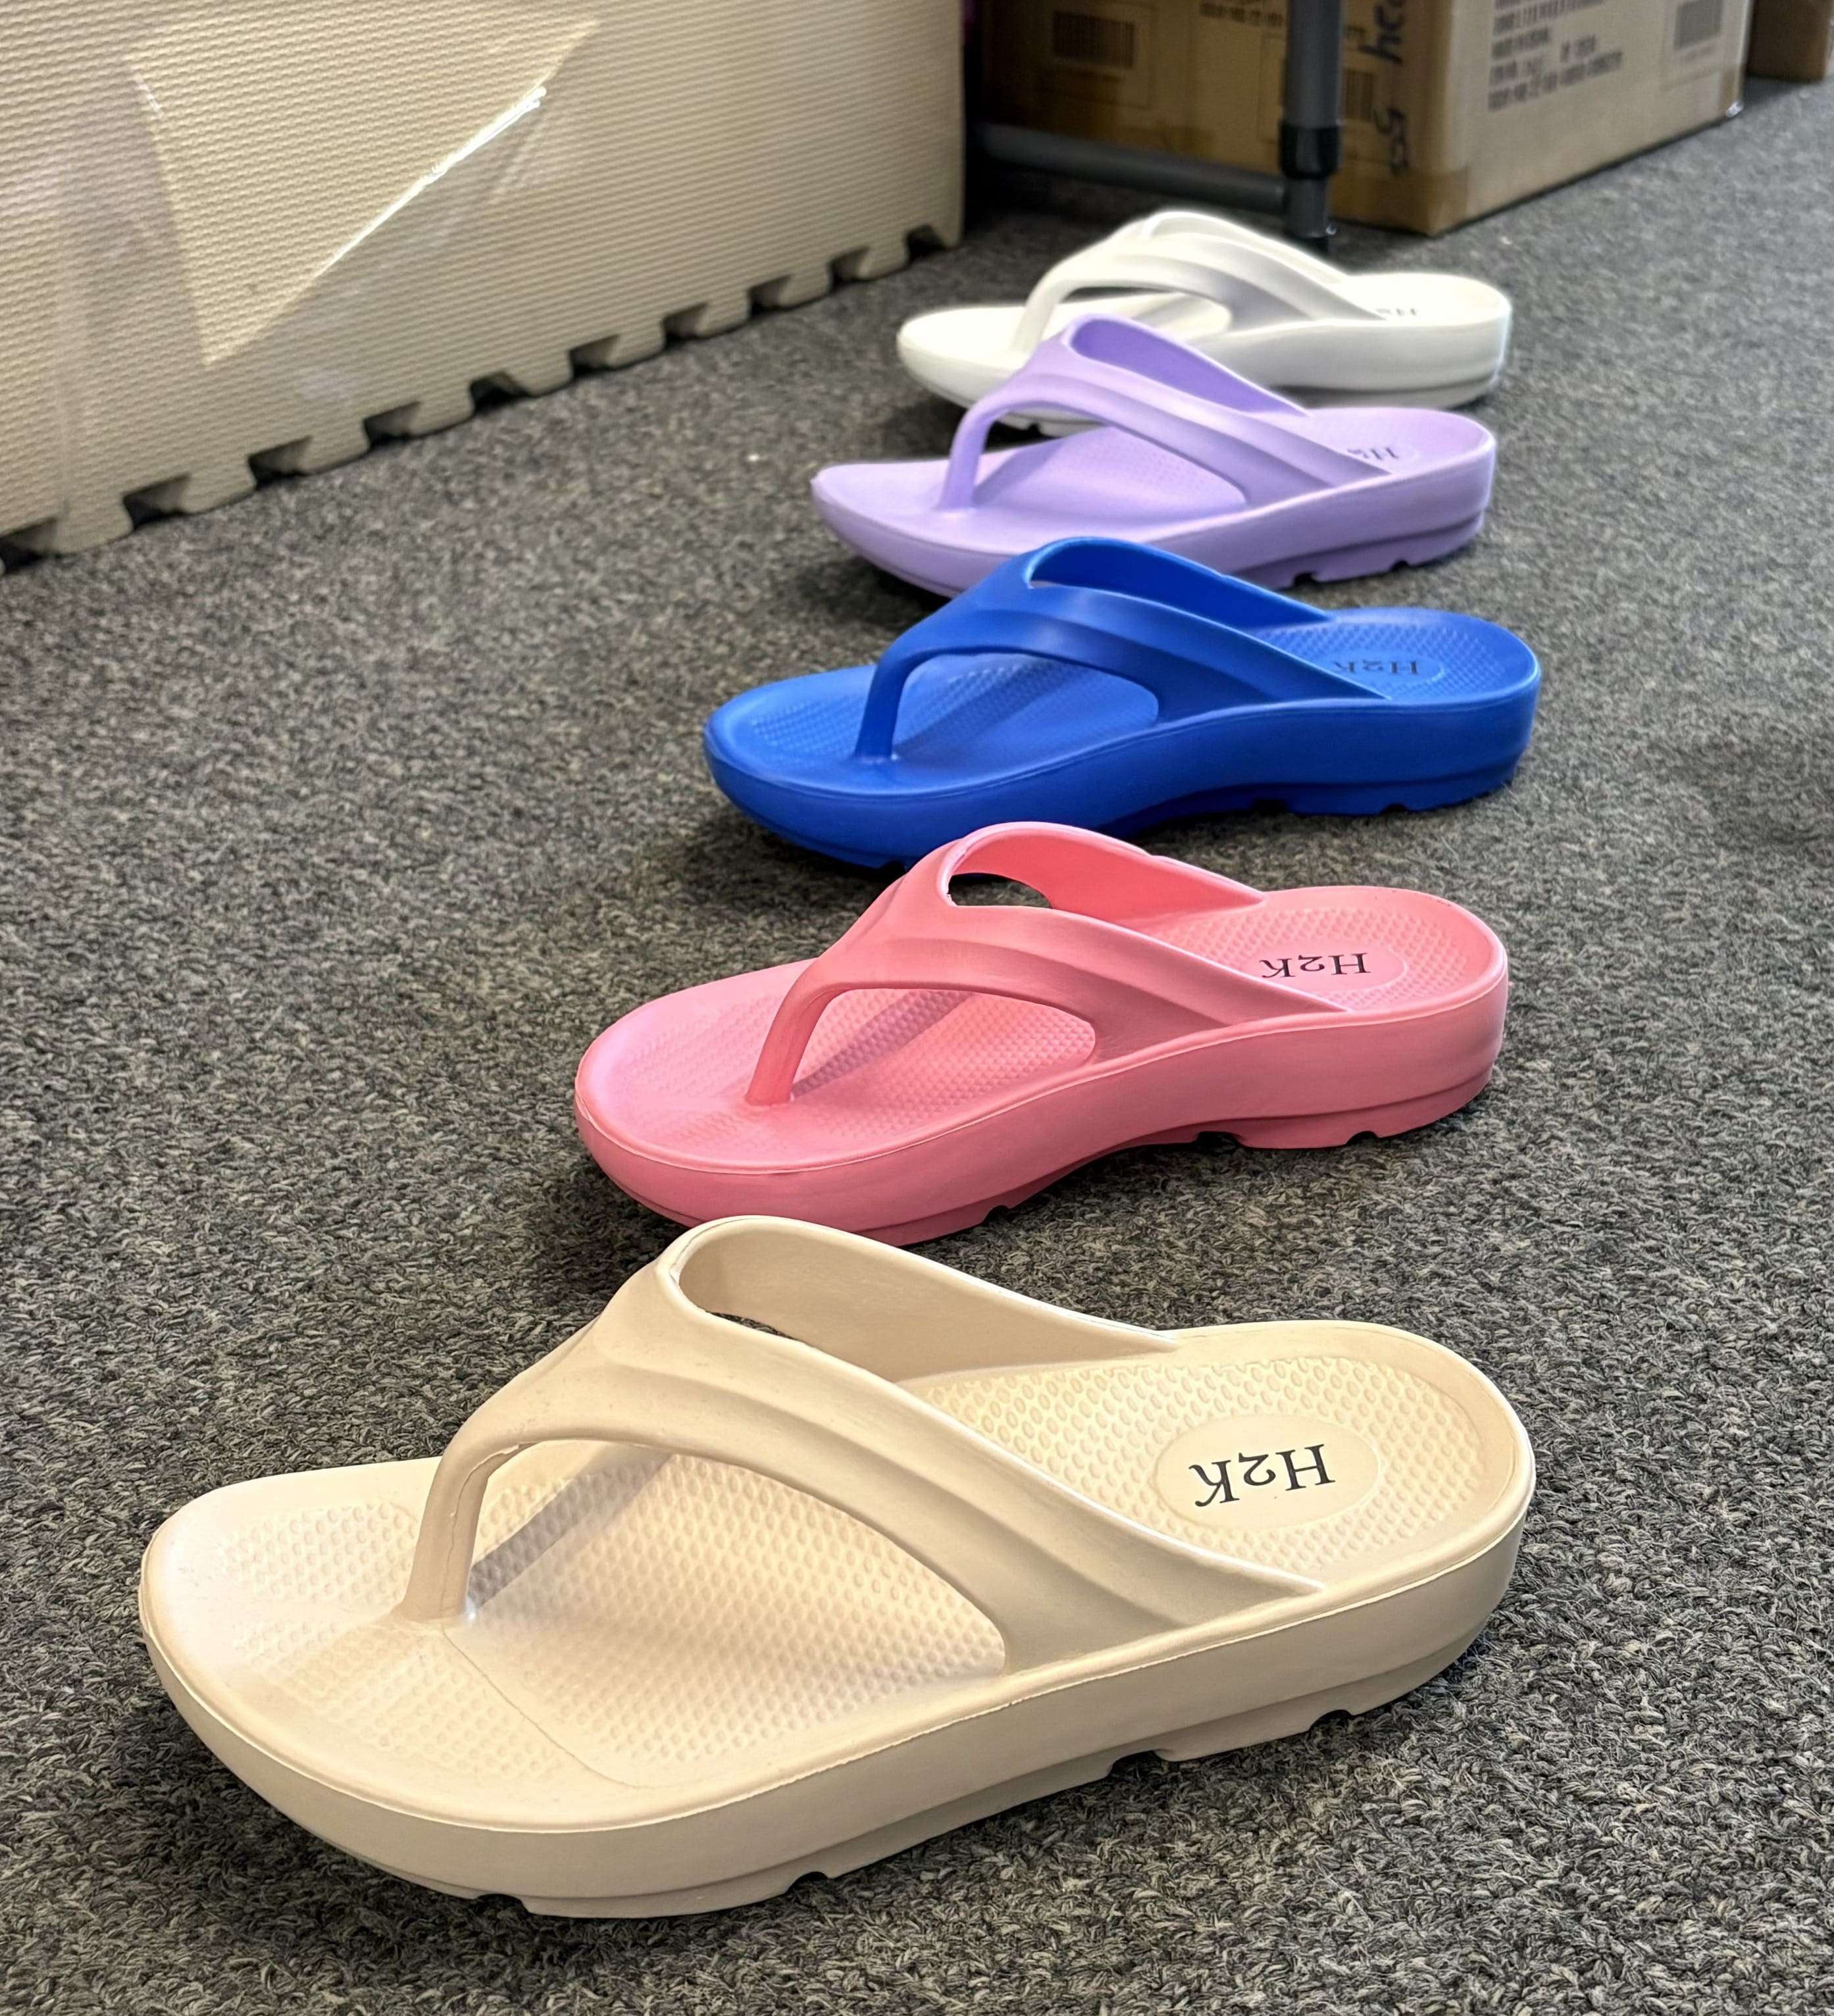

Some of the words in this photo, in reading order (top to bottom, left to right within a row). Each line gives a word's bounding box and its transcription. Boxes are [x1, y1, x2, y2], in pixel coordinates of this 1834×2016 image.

[1333, 660, 1419, 674] H2K
[1259, 952, 1371, 978] H2K
[1188, 1443, 1337, 1507] H2K
